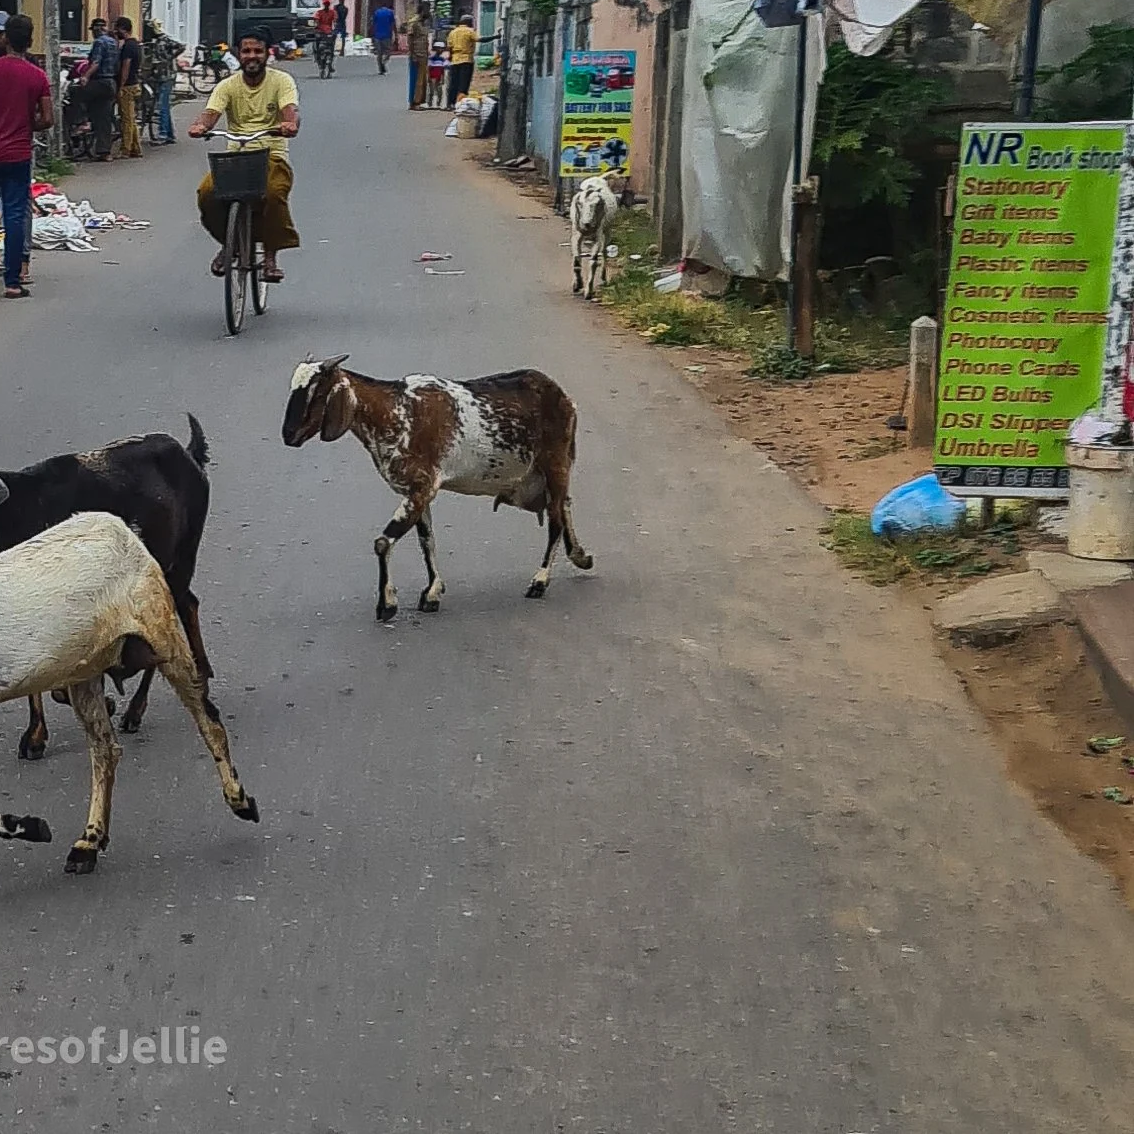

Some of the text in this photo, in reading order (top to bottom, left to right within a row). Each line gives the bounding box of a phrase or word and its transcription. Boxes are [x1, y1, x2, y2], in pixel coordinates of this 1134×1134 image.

[963, 131, 1124, 175] NR Book shop
[962, 177, 1072, 200] Stationary
[961, 204, 1060, 220] Gift items
[959, 228, 1076, 248] Baby items
[956, 256, 1089, 273] Plastic items
[953, 282, 1079, 301] Fancy items
[949, 306, 1109, 324] Cosmetic items
[946, 332, 1062, 354] Photocopy
[944, 358, 1080, 376] Phone Cards
[942, 385, 1053, 403] LED Bulbs
[940, 413, 984, 429] DSI
[939, 437, 1039, 458] Umbrella
